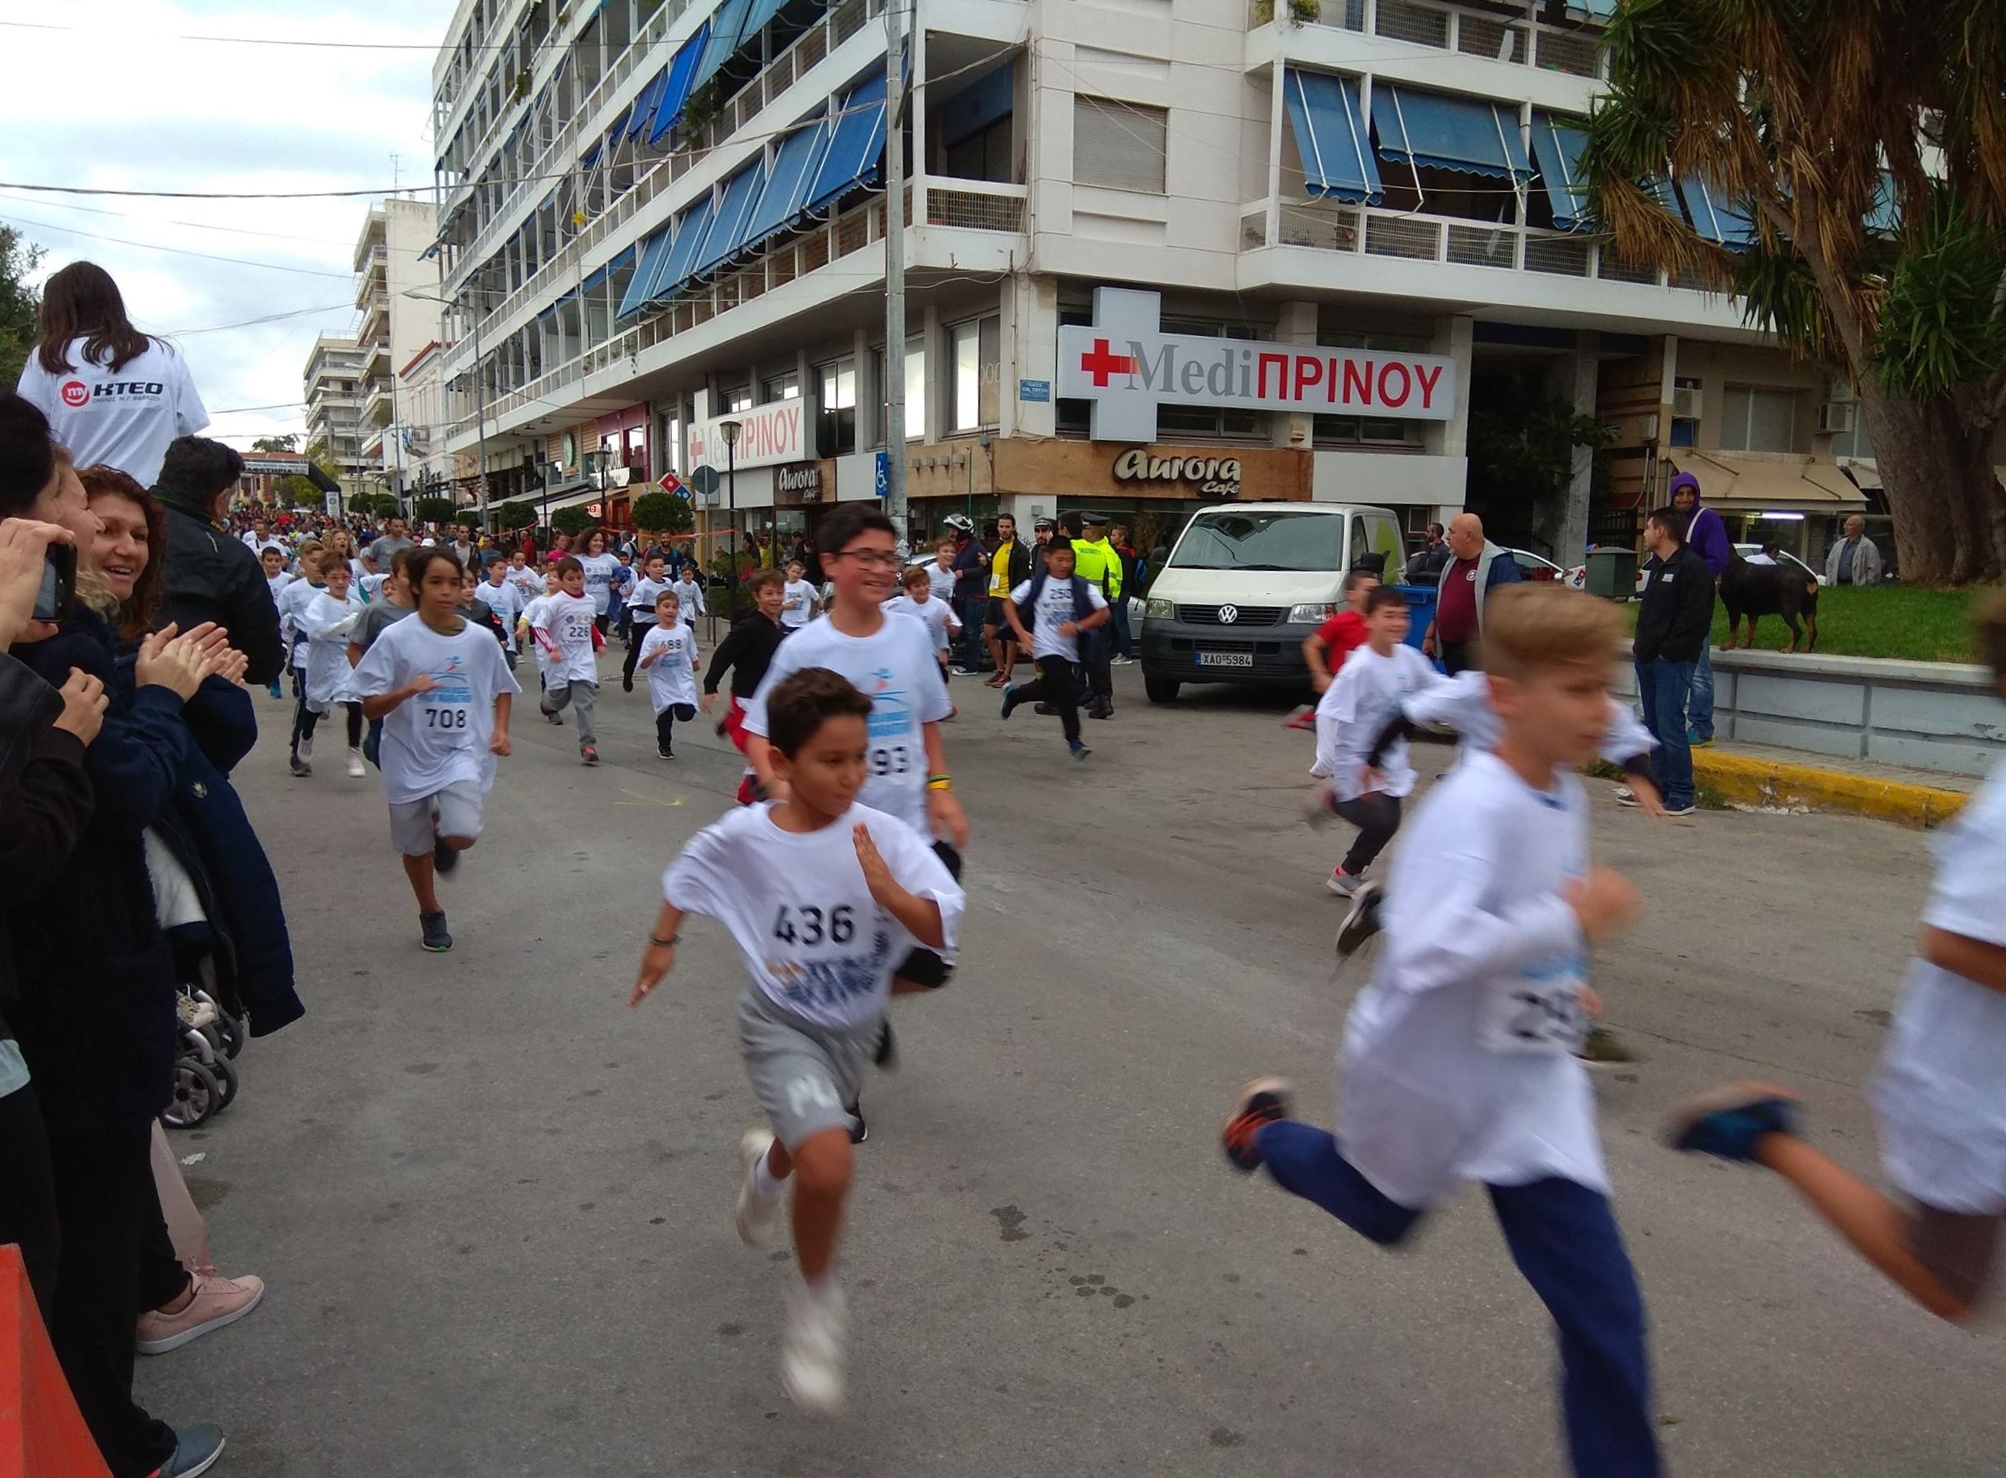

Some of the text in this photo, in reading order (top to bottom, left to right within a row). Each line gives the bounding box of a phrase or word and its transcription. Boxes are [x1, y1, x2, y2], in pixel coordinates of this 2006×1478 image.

[569, 626, 589, 638] 226
[425, 708, 467, 729] 708
[773, 903, 855, 946] 436
